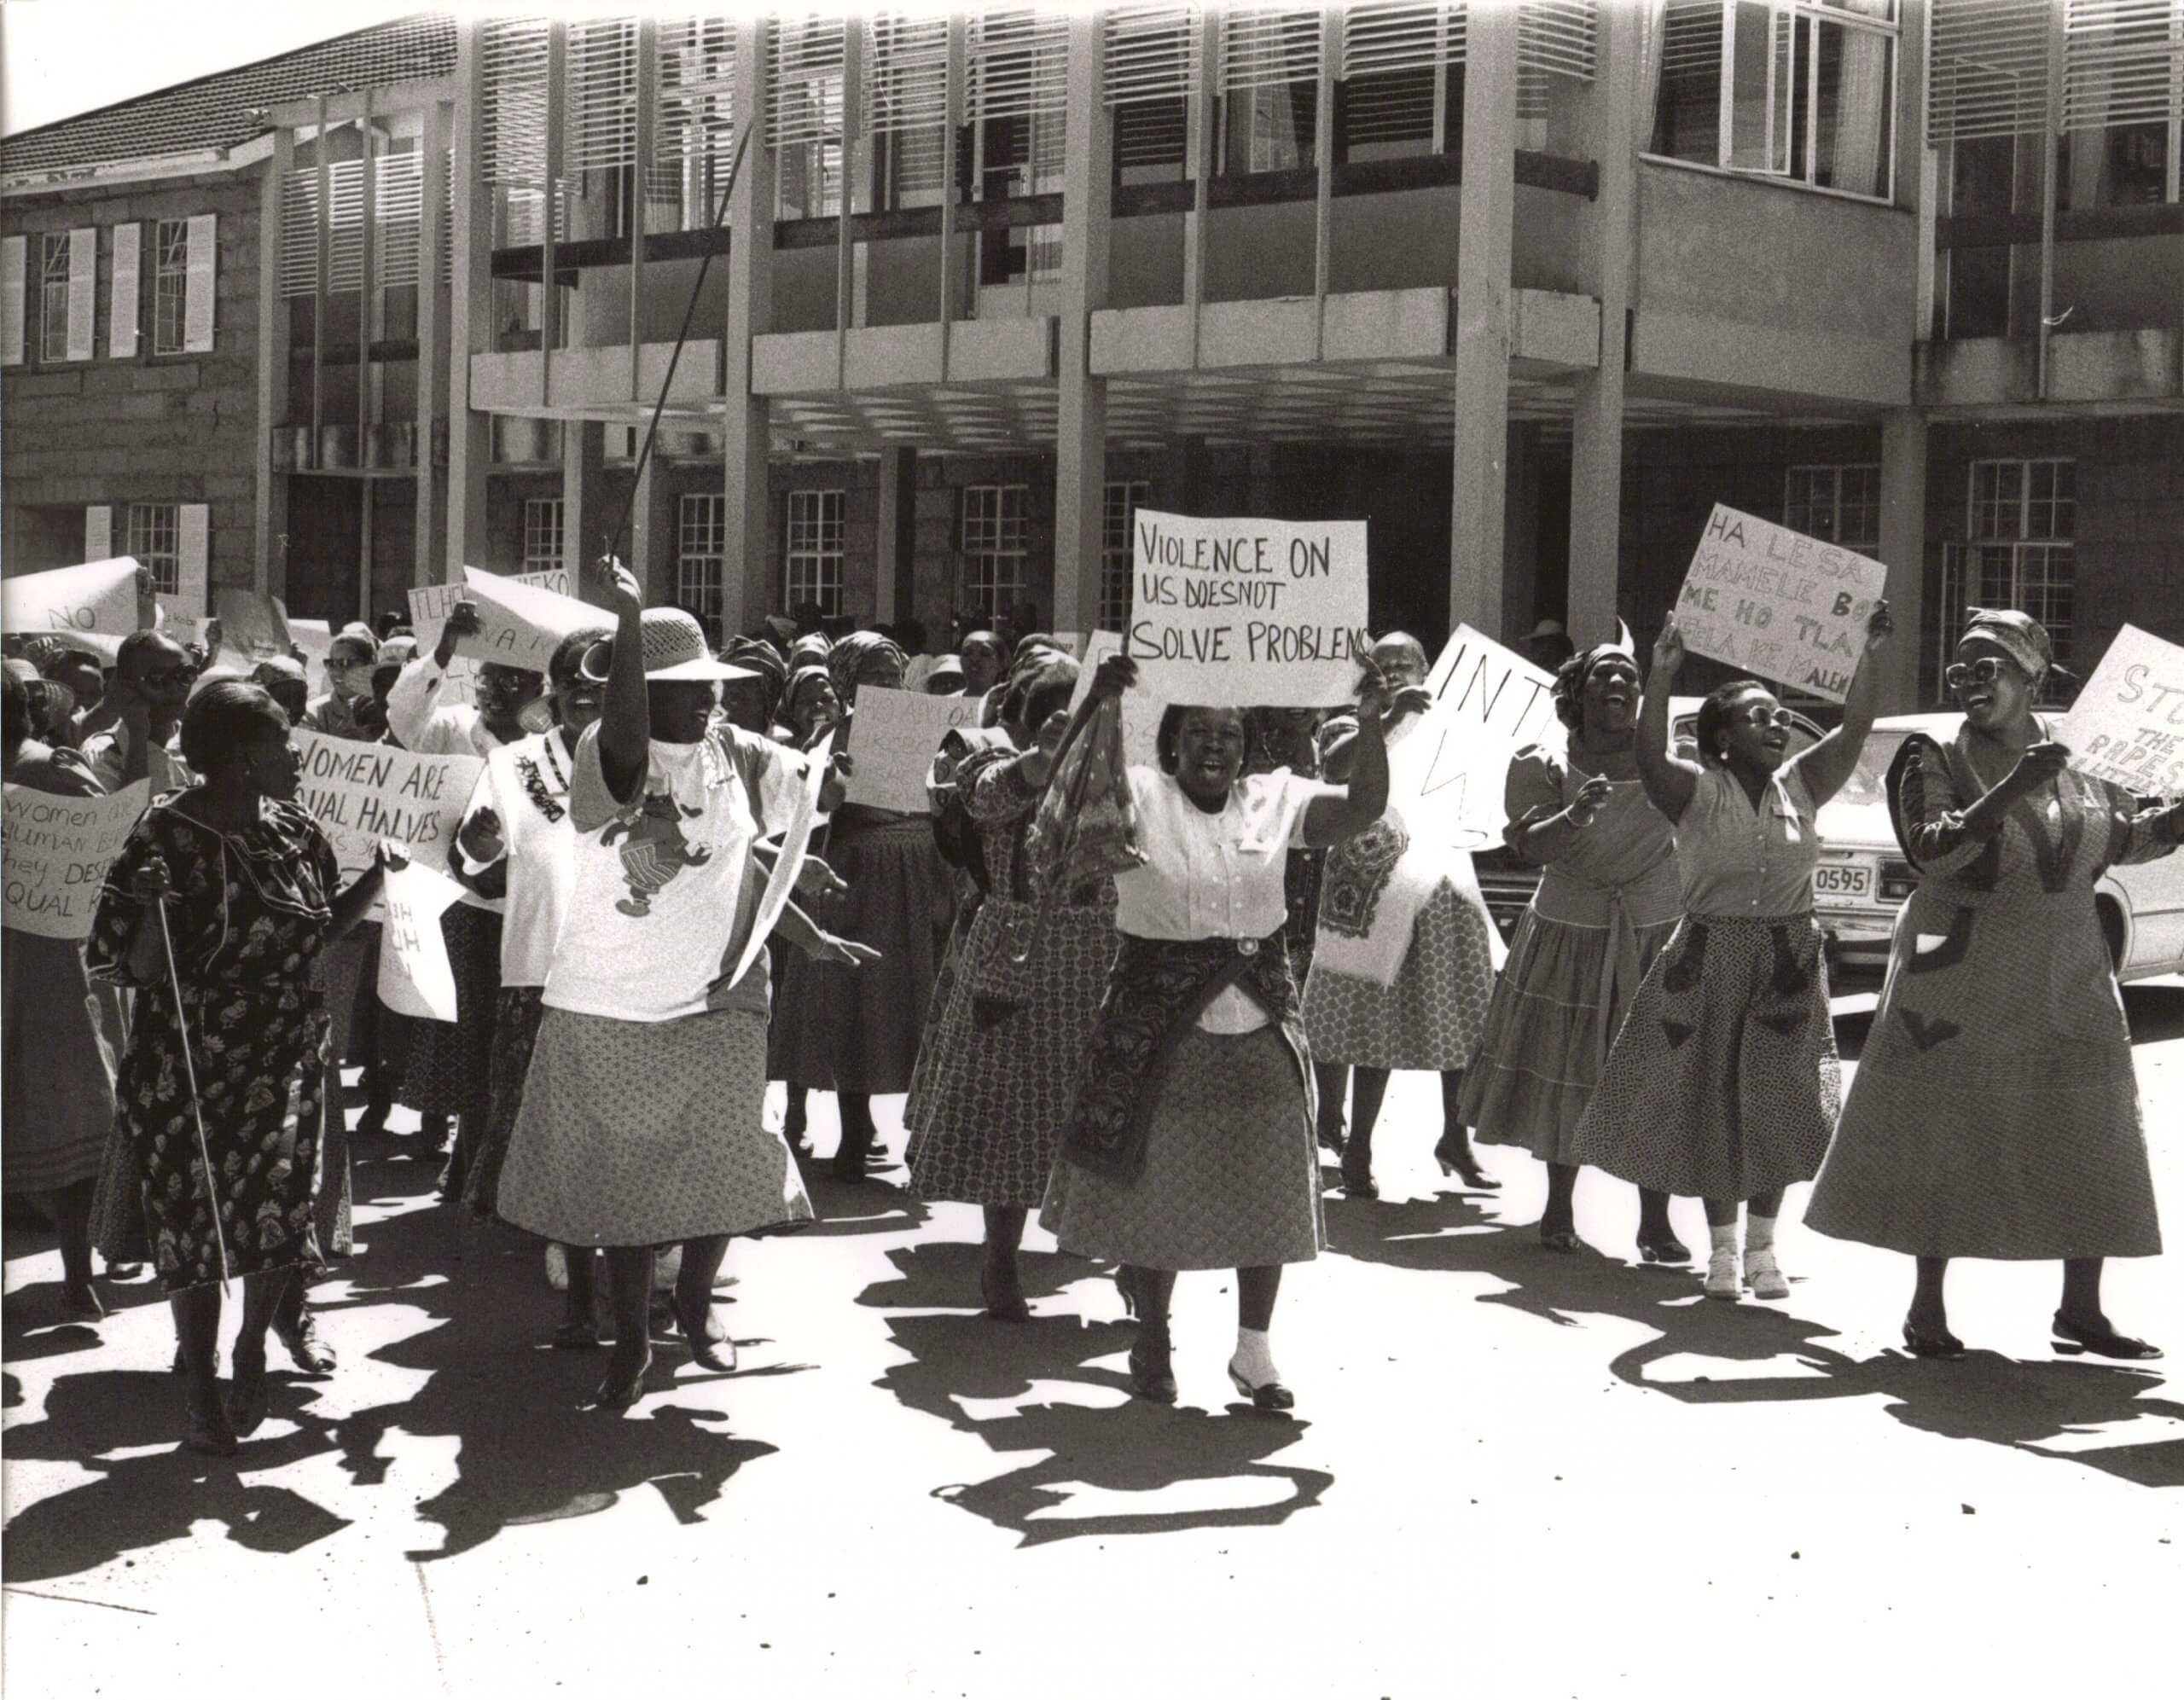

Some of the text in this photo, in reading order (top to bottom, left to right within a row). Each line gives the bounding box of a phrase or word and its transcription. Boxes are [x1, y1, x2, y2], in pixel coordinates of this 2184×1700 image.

[1707, 512, 1746, 548] HA
[1140, 522, 1330, 579] VIOLENCE ON
[1142, 572, 1178, 606] US
[1832, 591, 1871, 623] BO
[1131, 620, 1232, 663] SOLVE
[1734, 598, 1774, 630] HO
[1794, 614, 1854, 659] TLA
[2134, 727, 2184, 756] THE
[399, 762, 450, 801] ARE
[356, 796, 441, 844] HALVES
[1815, 868, 1864, 891] 0595
